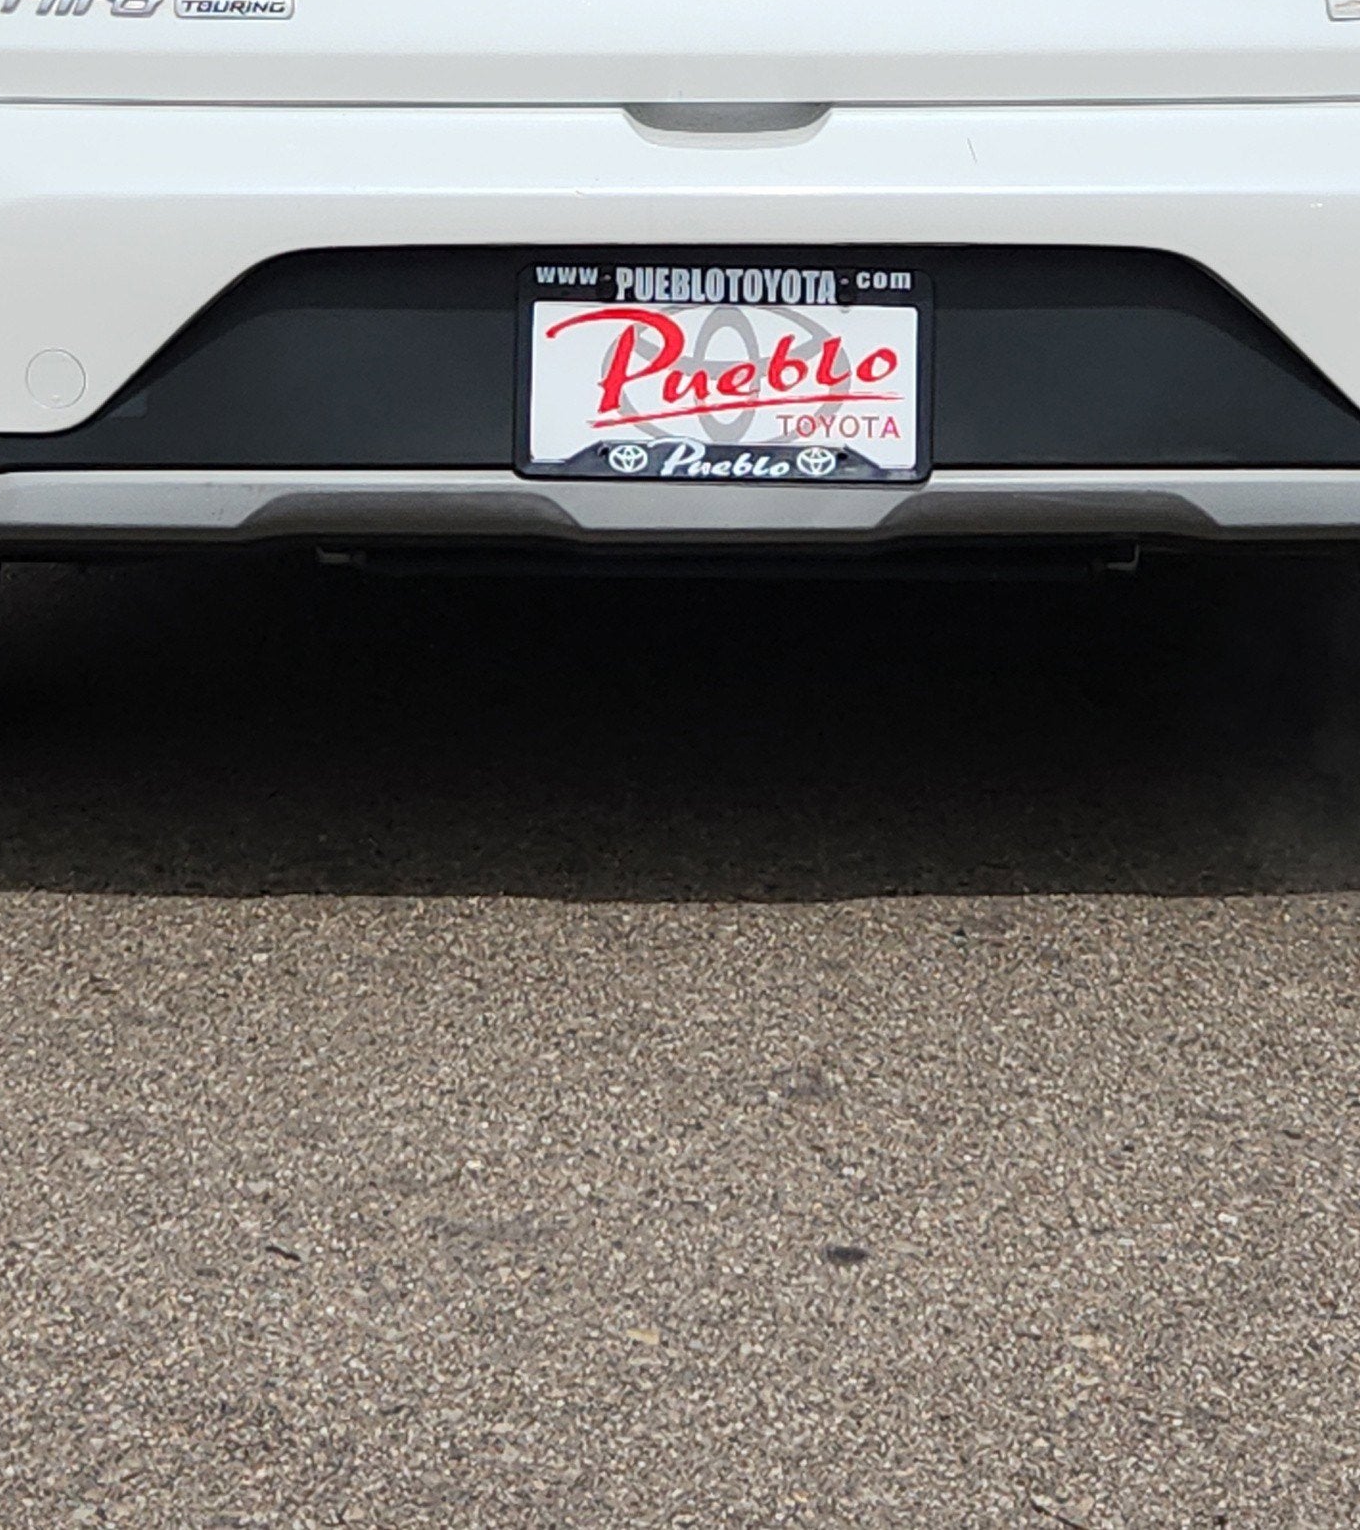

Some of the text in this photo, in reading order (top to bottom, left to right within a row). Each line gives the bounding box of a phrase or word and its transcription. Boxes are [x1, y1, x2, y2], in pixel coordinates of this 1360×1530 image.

[545, 308, 899, 414] Pueblo
[776, 414, 901, 439] TOYOTA
[647, 437, 791, 477] Pueblo
